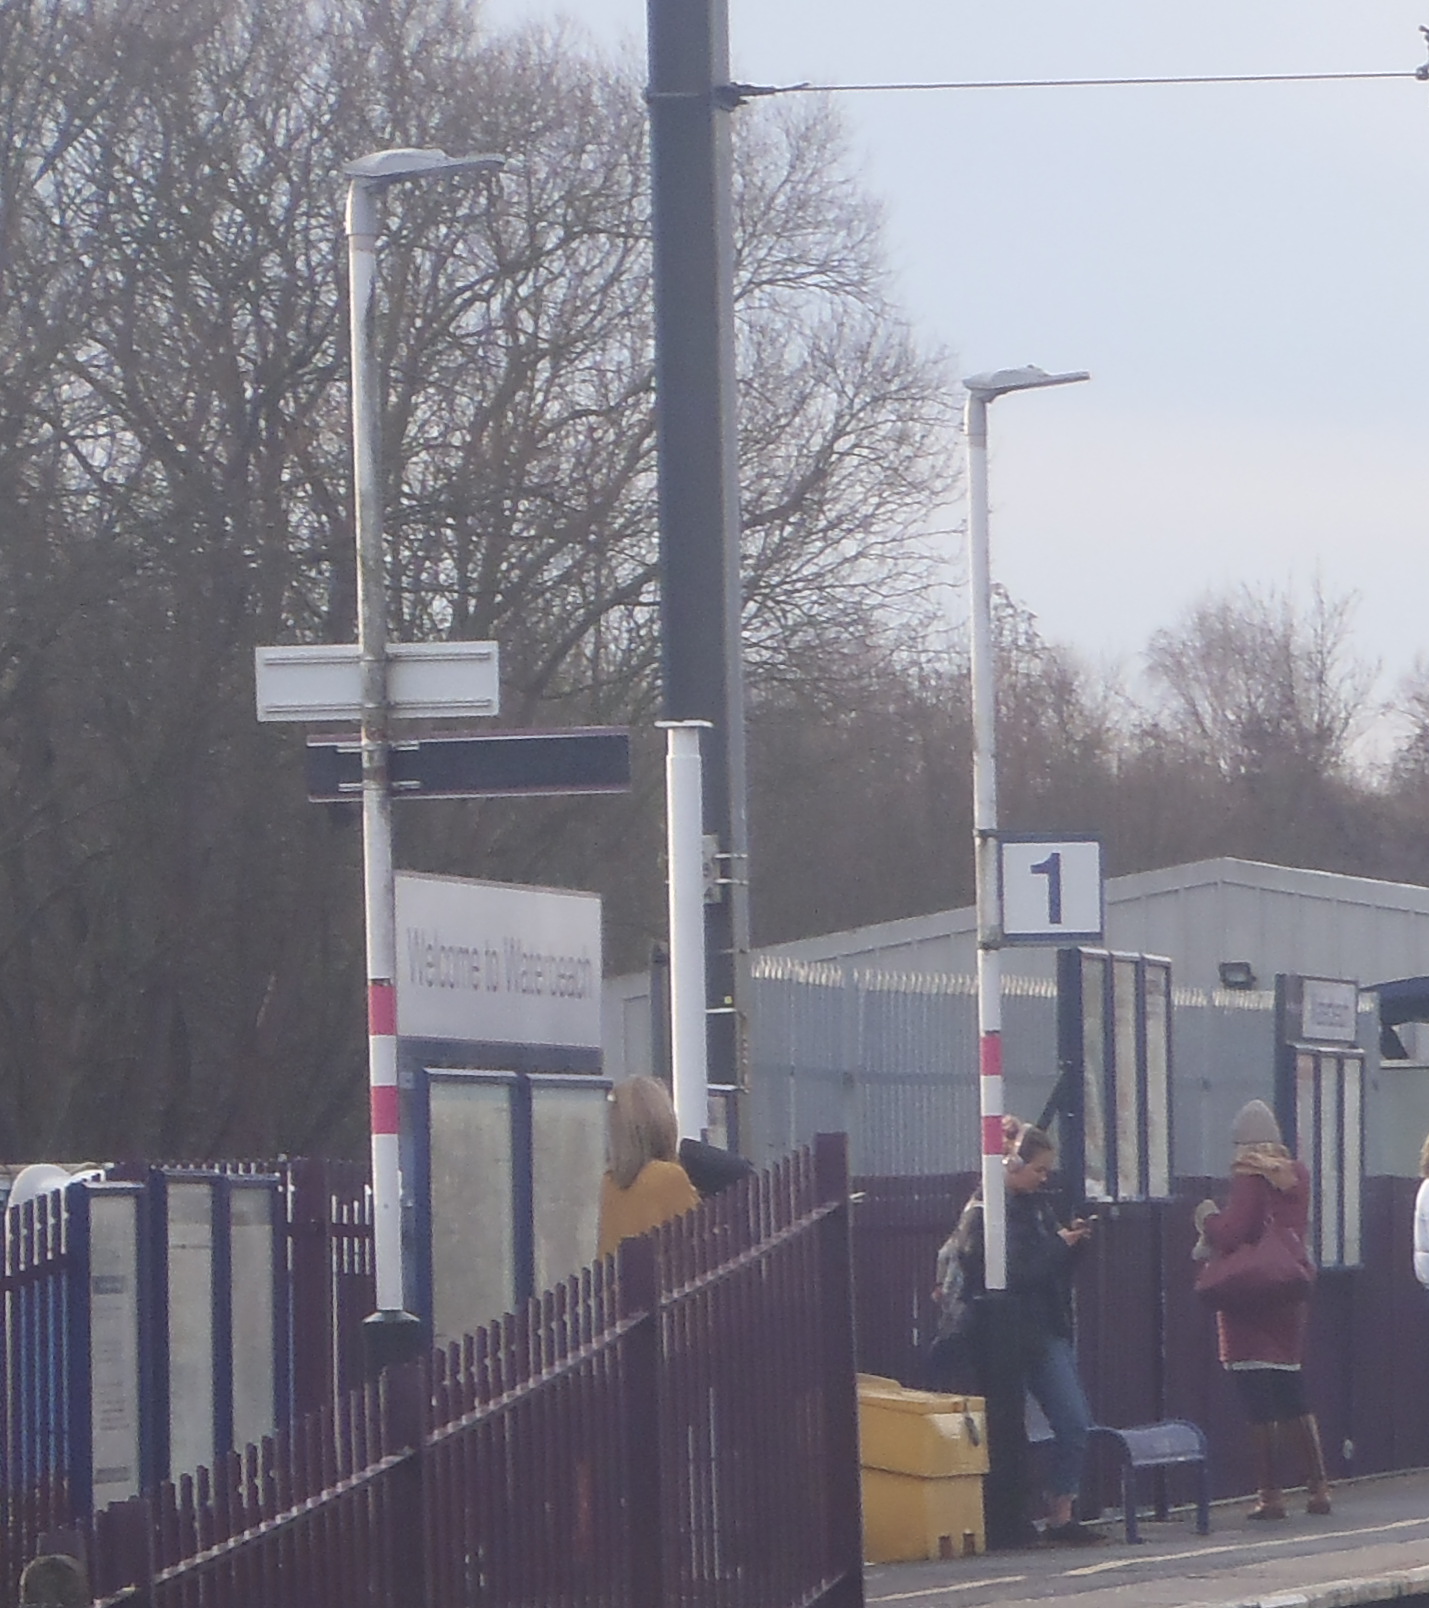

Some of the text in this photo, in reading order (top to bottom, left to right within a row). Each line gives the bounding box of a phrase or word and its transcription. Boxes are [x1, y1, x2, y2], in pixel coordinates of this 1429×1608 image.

[1030, 852, 1062, 924] 1
[407, 927, 593, 1001] Welcome to Waterbeach
